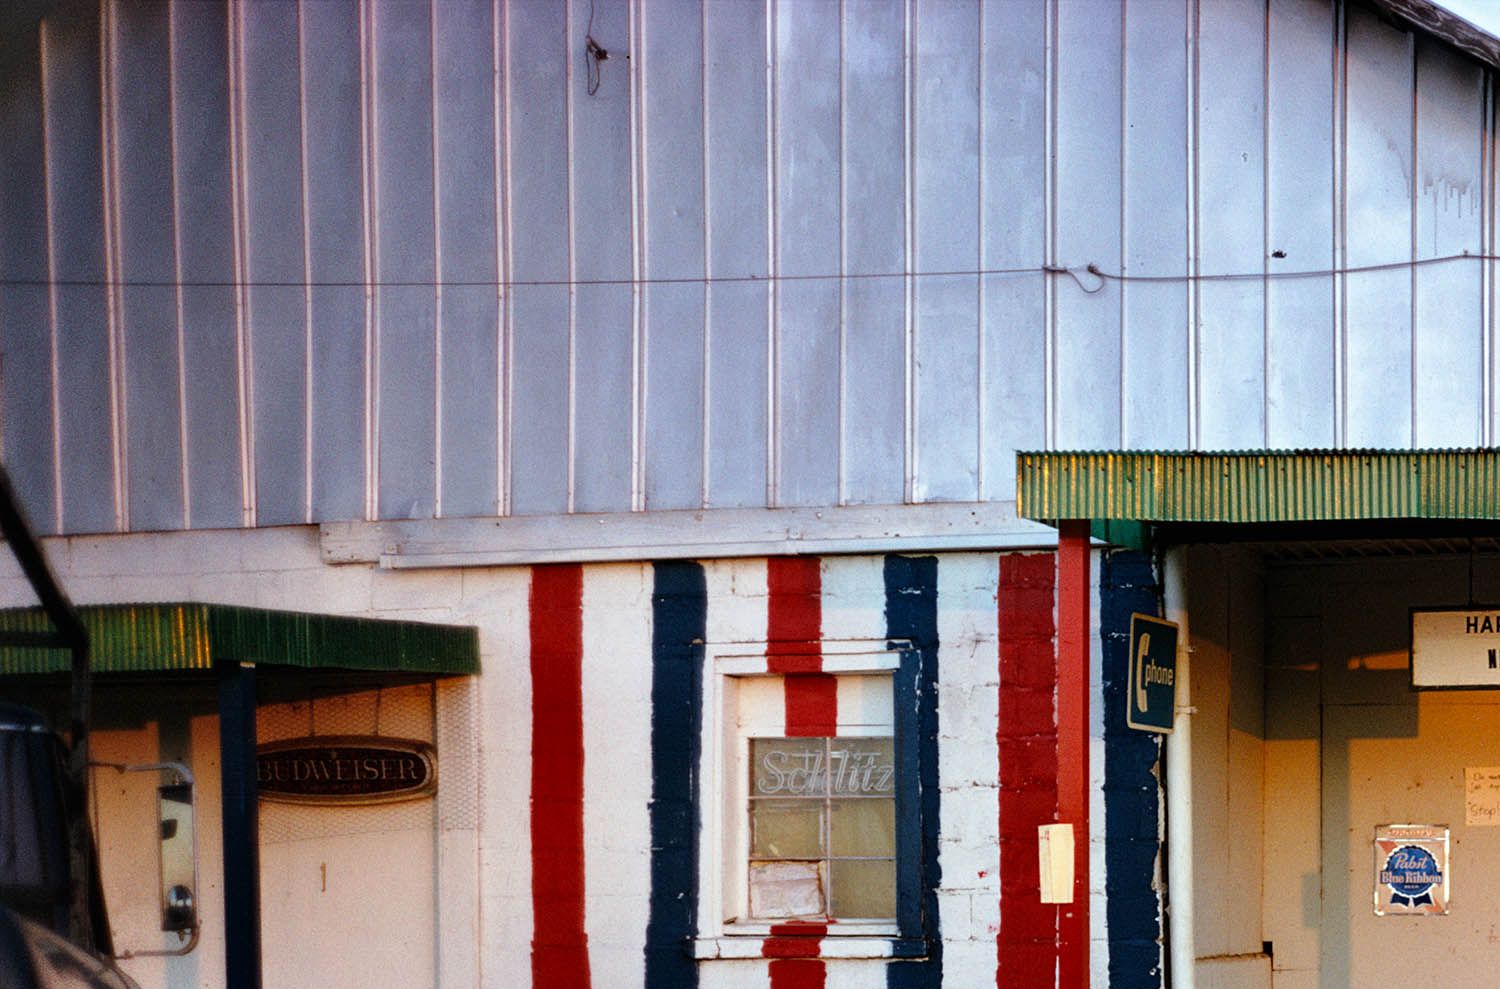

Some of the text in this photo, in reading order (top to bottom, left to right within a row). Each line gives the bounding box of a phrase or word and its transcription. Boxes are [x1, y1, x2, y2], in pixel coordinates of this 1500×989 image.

[1145, 659, 1173, 687] phone
[256, 759, 418, 782] BUDWEISER
[758, 750, 894, 794] Schlitz
[1394, 852, 1428, 869] Pabst
[1381, 871, 1442, 883] Blue Ribbon
